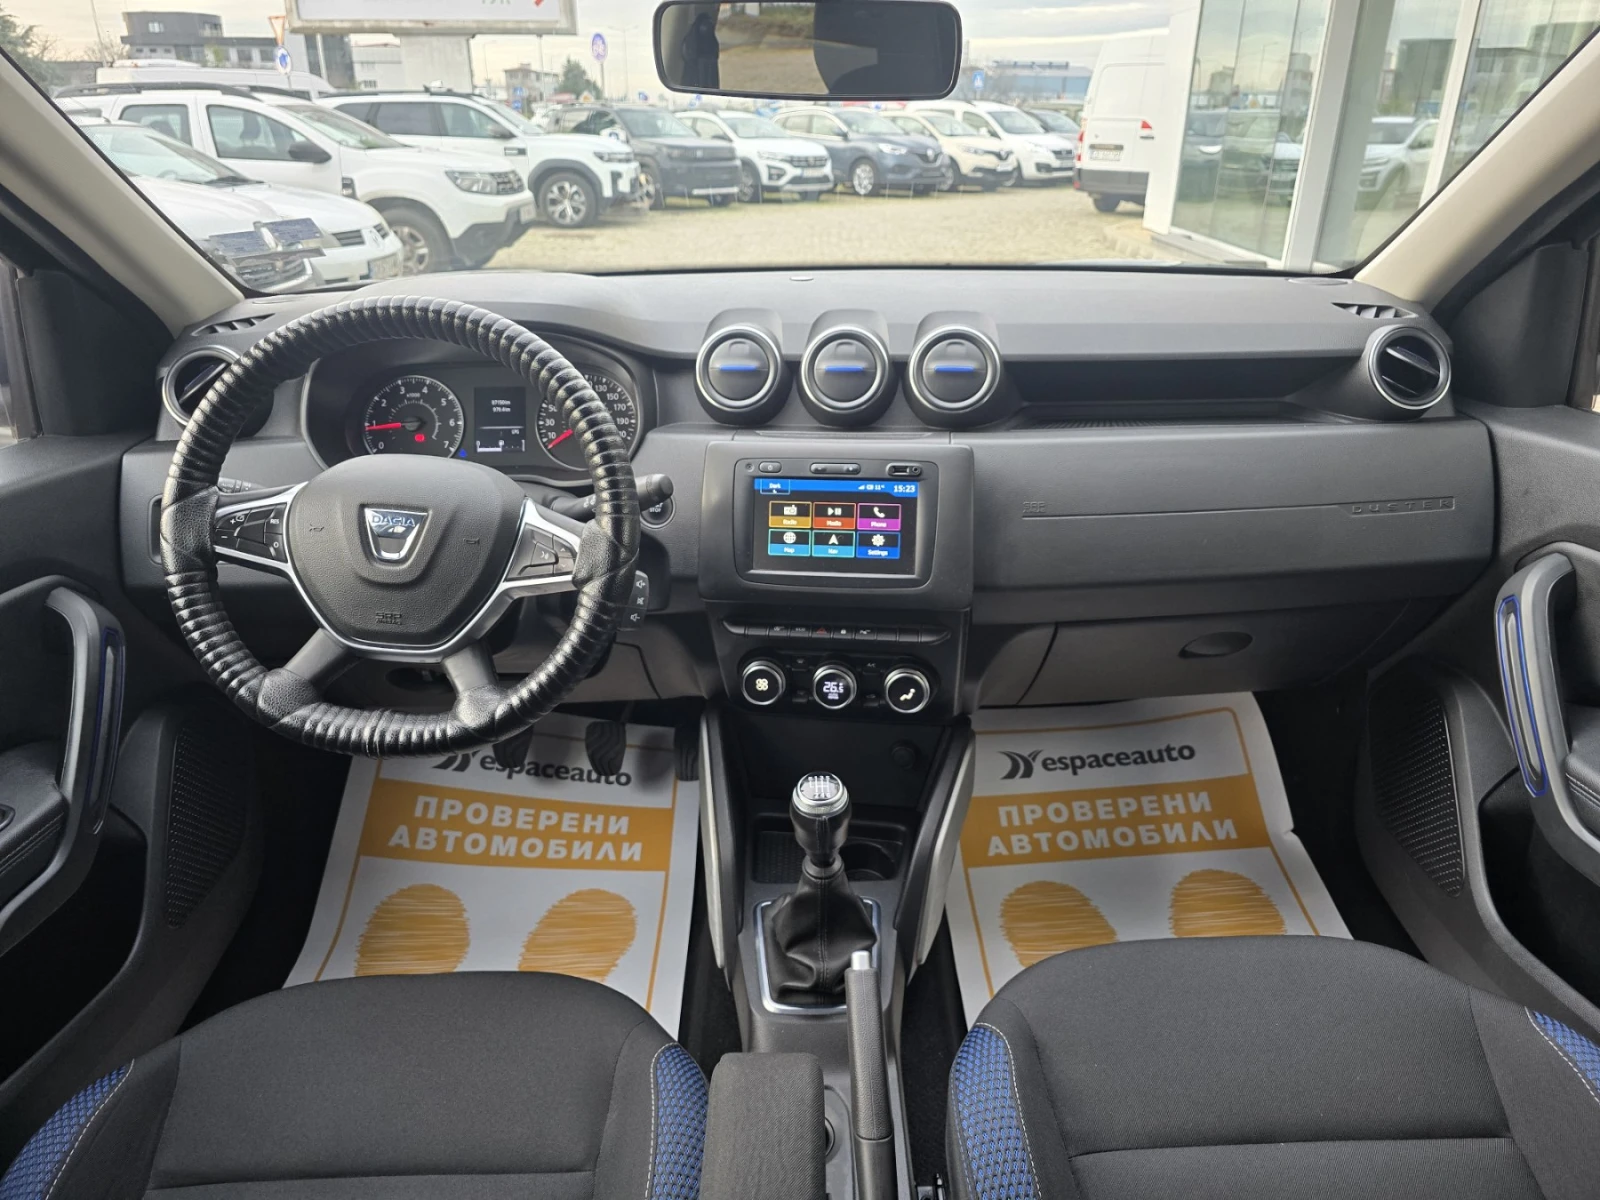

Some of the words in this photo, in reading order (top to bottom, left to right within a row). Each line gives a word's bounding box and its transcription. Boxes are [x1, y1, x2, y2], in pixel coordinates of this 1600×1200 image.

[400, 386, 406, 394] 3
[422, 386, 428, 394] 4
[606, 393, 619, 401] 150
[381, 399, 387, 407] 2
[441, 398, 447, 406] 5
[449, 418, 455, 426] 6
[545, 418, 555, 426] 30
[894, 485, 915, 493] 15:23
[1352, 499, 1450, 513] DUSTER
[373, 515, 416, 527] DACIA
[868, 549, 888, 557] Settings
[1041, 743, 1196, 776] espaceauto
[998, 791, 1212, 827] ПРОВЕРЕНИ
[414, 795, 629, 835] ПРОВЕРЕНИ
[988, 819, 1238, 857] АВТОМОБИЛИ
[388, 825, 642, 862] АВТОМОБИЛИ
